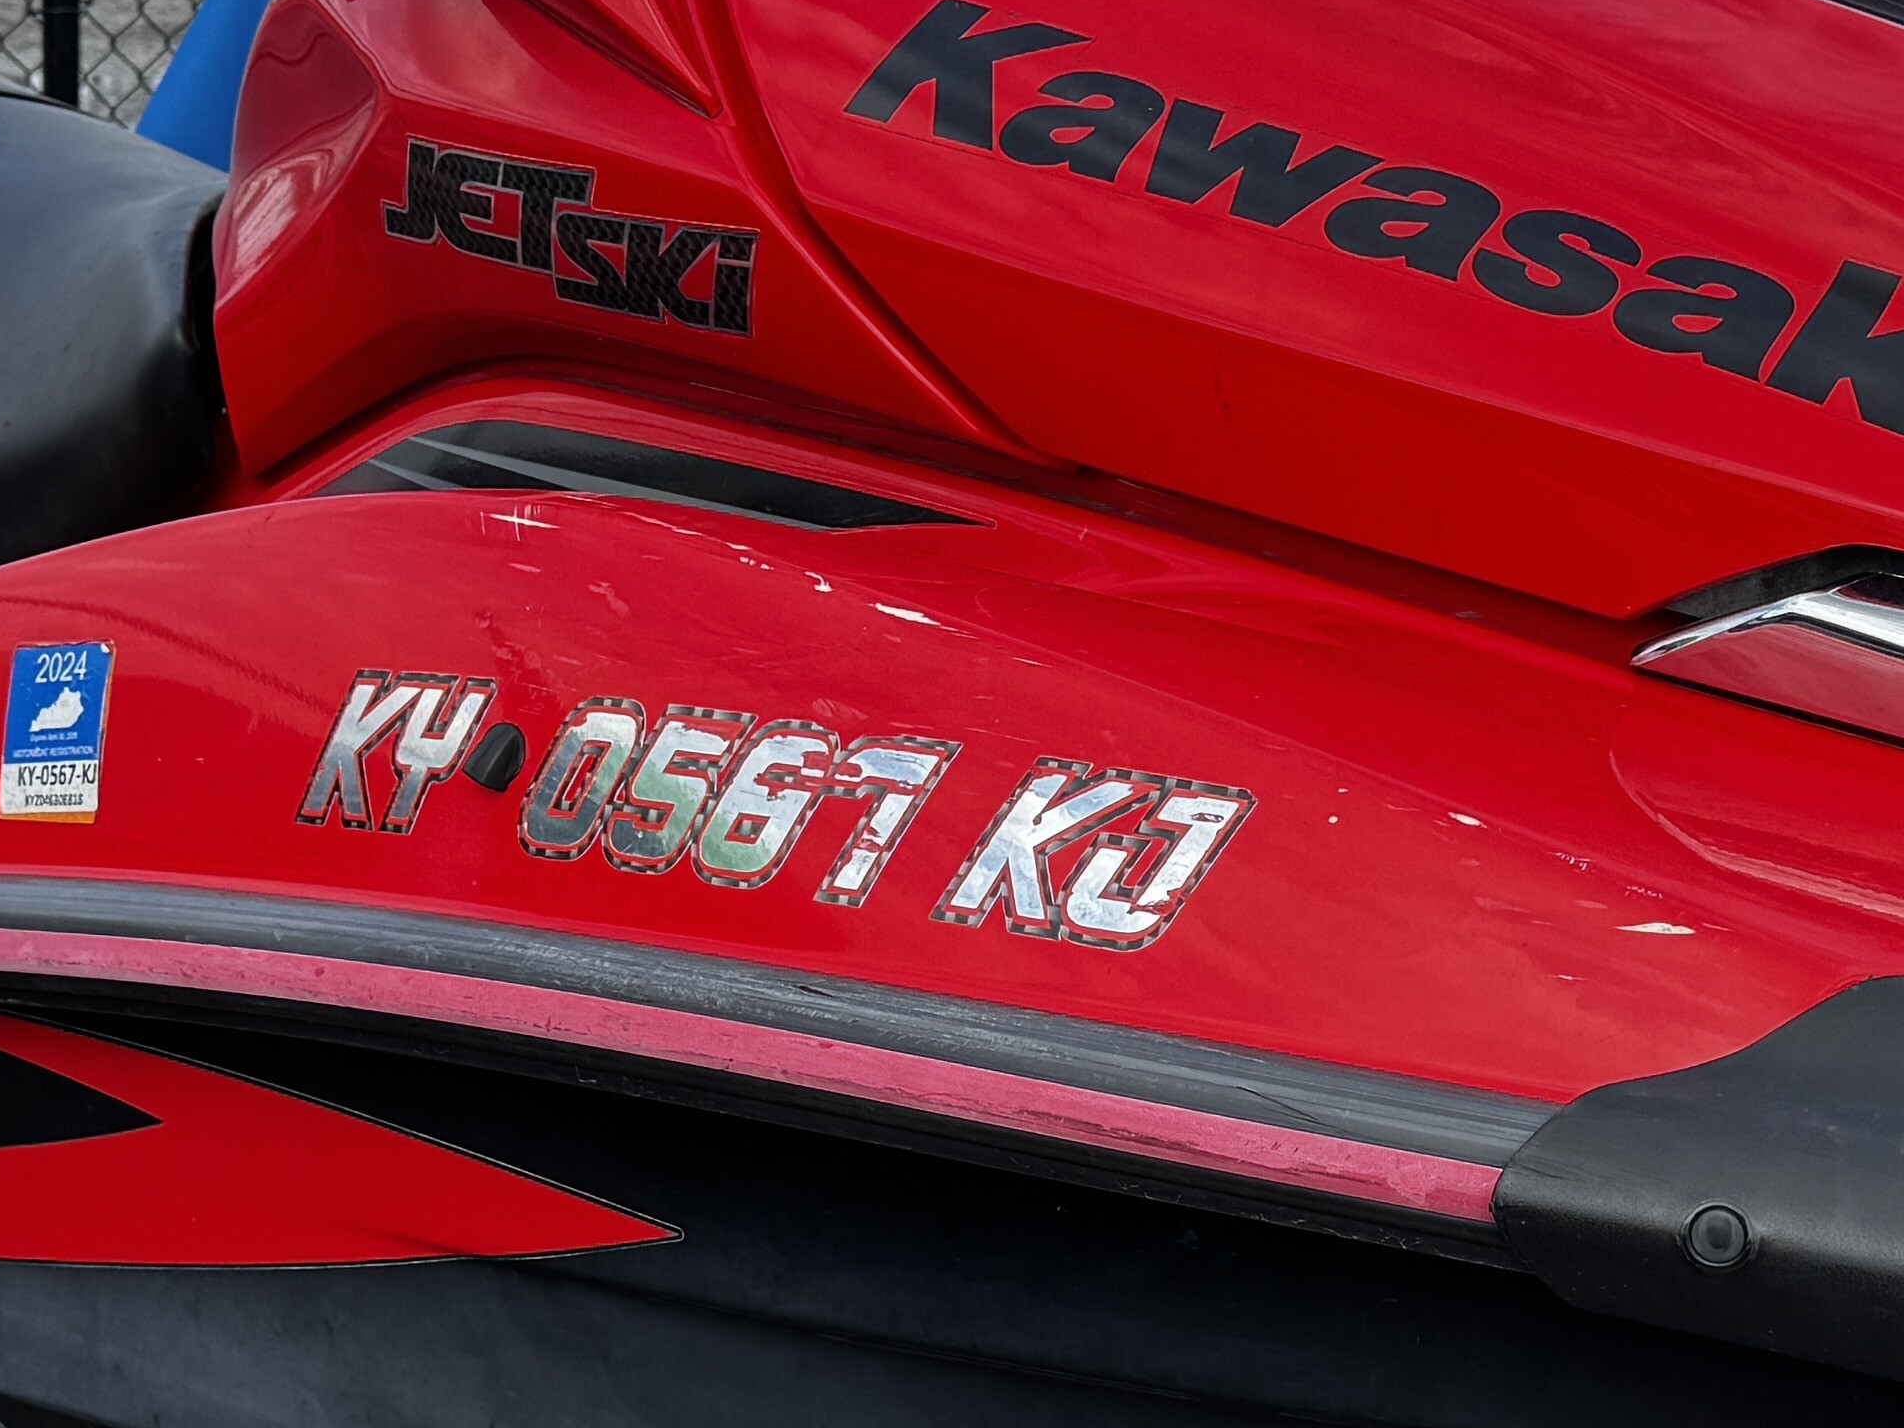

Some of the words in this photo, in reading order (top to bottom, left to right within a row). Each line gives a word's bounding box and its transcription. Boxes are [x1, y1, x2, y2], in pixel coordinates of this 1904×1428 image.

[35, 650, 87, 683] 2024
[17, 763, 97, 786] KY-0567-KJ
[293, 668, 497, 834] KY
[515, 696, 964, 908] 0567
[928, 757, 1259, 953] KJ
